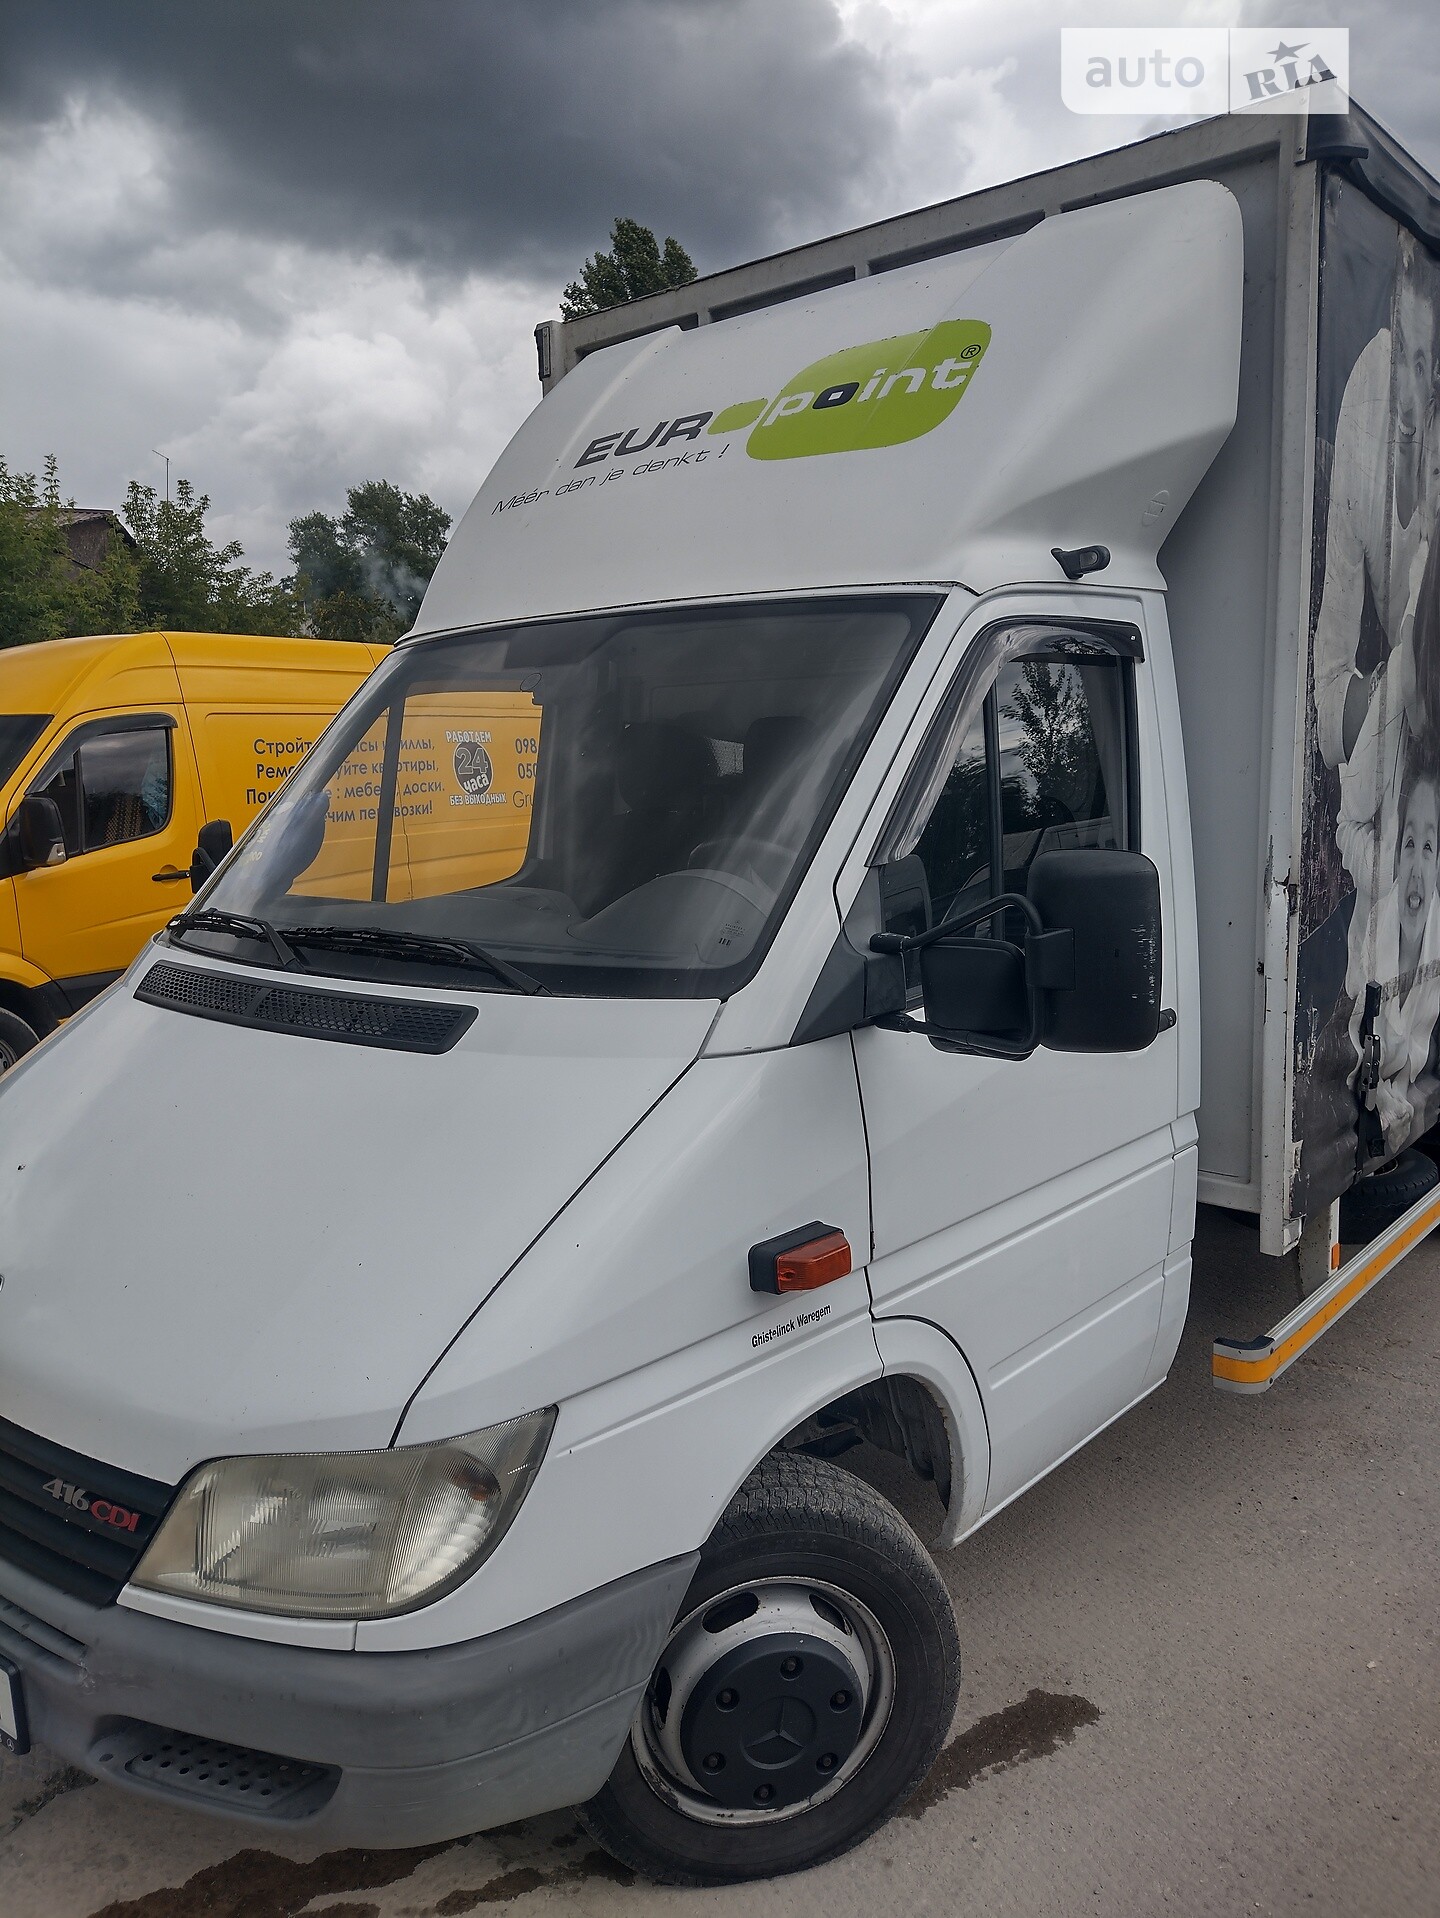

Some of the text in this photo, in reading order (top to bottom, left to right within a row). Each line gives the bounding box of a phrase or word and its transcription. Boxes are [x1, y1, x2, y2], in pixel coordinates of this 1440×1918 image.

[555, 476, 596, 496] dan
[599, 467, 625, 487] je
[632, 449, 711, 476] denkt
[254, 737, 313, 757] Стройт
[399, 739, 435, 750] иллы,
[445, 731, 492, 743] РАБОТАЕМ
[515, 738, 537, 754] 098
[455, 747, 489, 775] 24
[403, 781, 445, 796] доски.
[463, 772, 490, 793] часа
[449, 793, 507, 806] БЕЗ ВЫХОДНЫХ
[796, 1304, 832, 1327] Waregem
